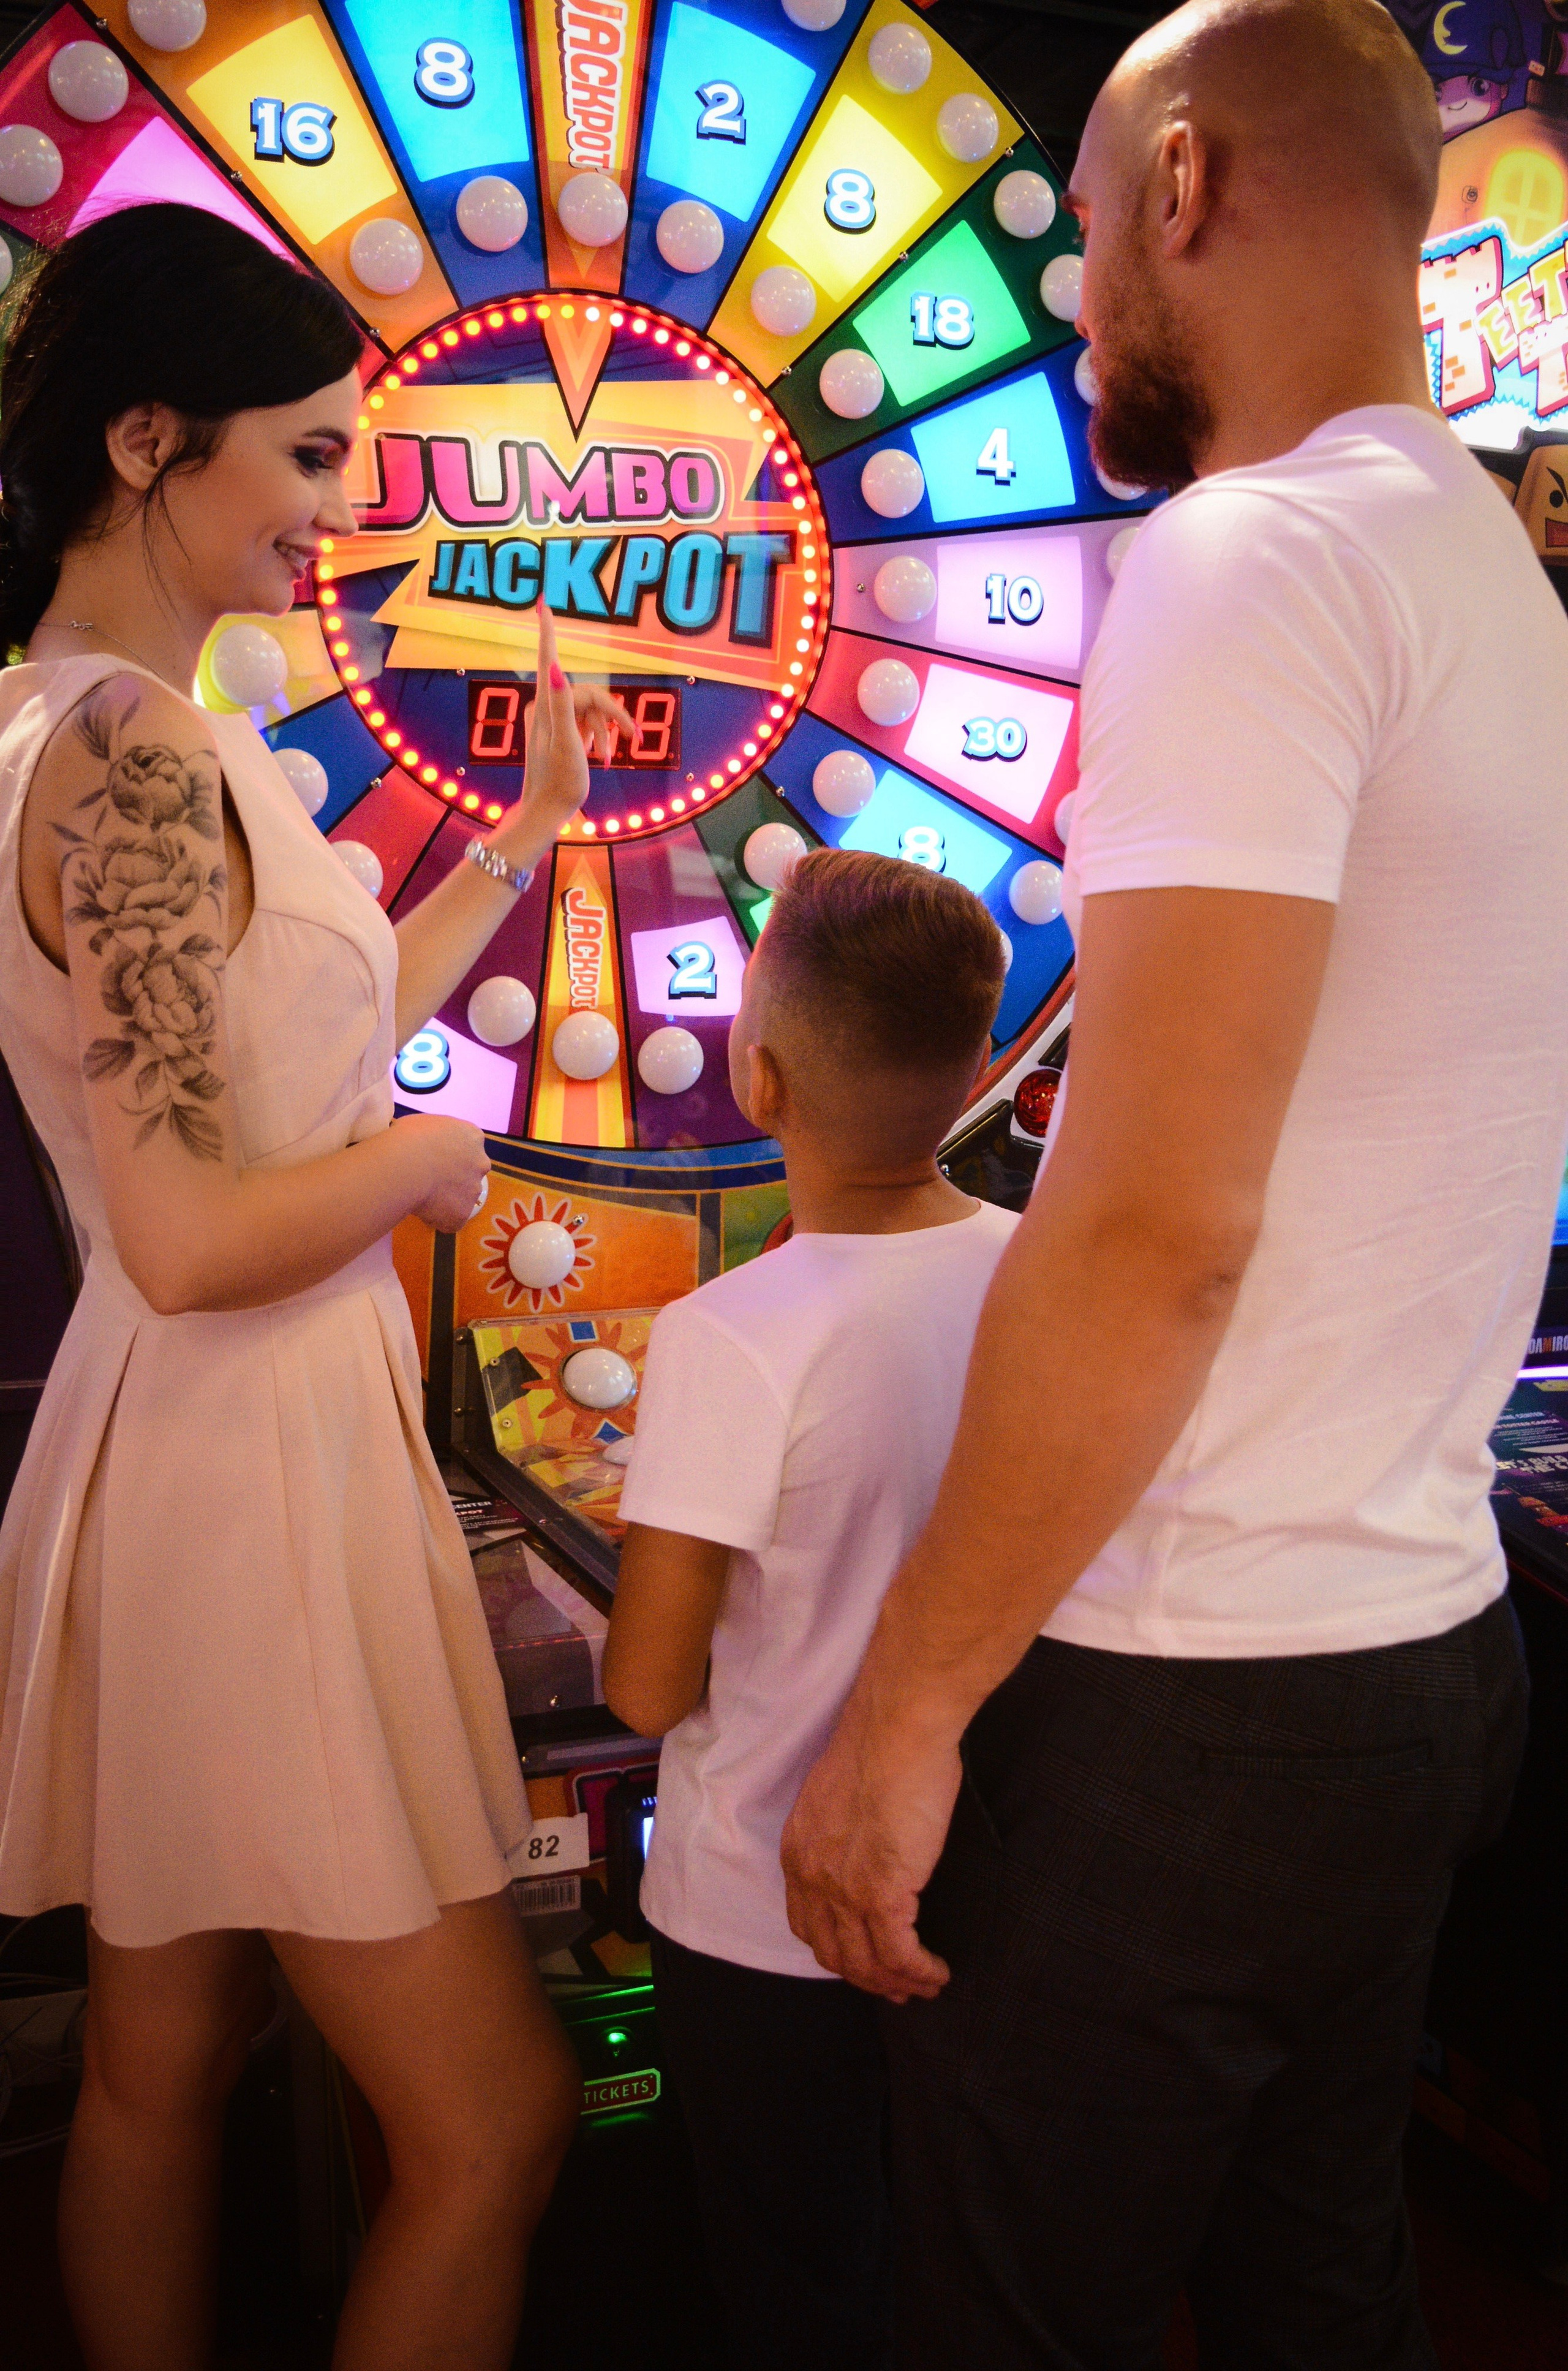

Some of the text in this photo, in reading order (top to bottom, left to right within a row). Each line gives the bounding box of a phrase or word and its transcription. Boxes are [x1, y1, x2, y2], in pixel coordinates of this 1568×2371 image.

[415, 37, 474, 107] 8
[251, 97, 336, 165] 16
[696, 80, 745, 143] 2
[825, 168, 876, 233] 8
[911, 290, 975, 350] 18
[353, 433, 724, 532] JUMBO
[976, 428, 1016, 485] 4
[428, 531, 796, 647] JACKPOT
[986, 573, 1044, 626] 10
[962, 716, 1027, 762] 30
[898, 826, 946, 873] 8
[564, 887, 606, 1009] JACKPOT
[666, 942, 717, 999] 2
[394, 1028, 451, 1094] 8
[529, 1835, 560, 1859] 82
[584, 2081, 649, 2103] TICKETS
